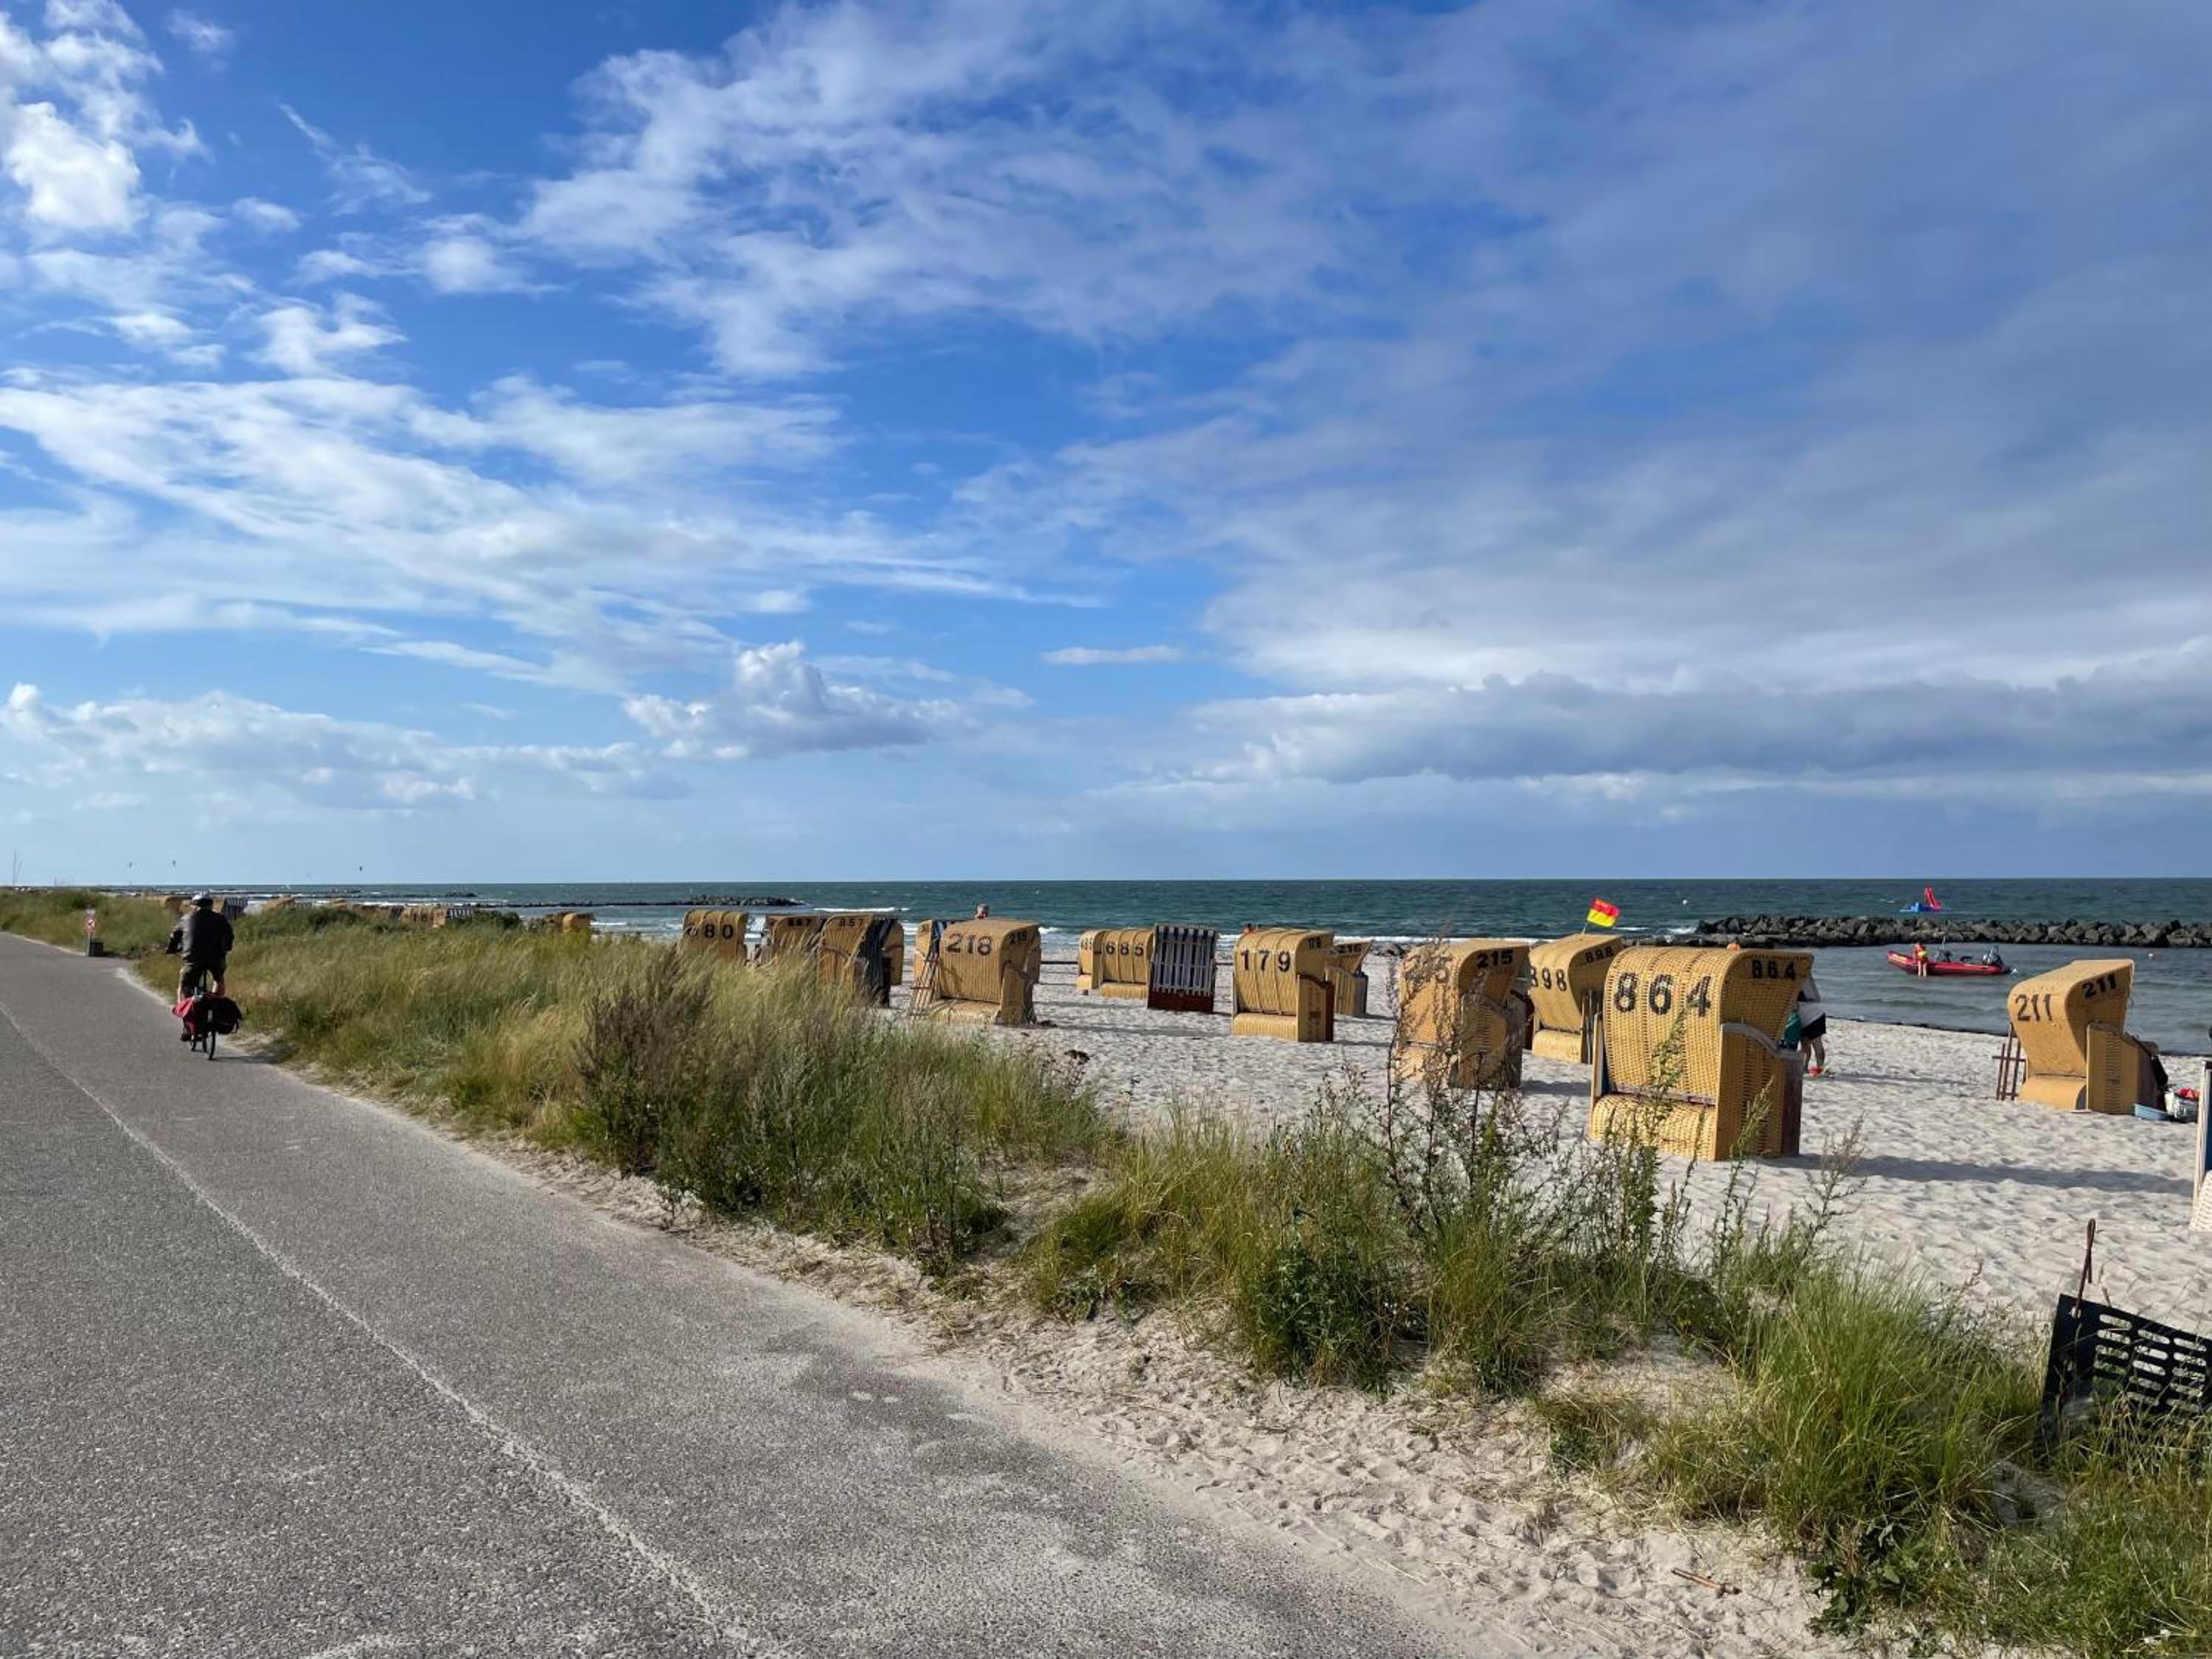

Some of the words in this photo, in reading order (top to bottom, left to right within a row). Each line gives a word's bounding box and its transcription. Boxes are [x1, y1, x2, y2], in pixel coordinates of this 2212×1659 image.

[946, 933, 992, 956] 218
[1107, 942, 1144, 956] 685
[1241, 949, 1291, 972] 179
[1477, 950, 1513, 968] 215
[1614, 973, 1711, 1017] 864
[2082, 973, 2116, 998] 211
[2015, 994, 2051, 1021] 211
